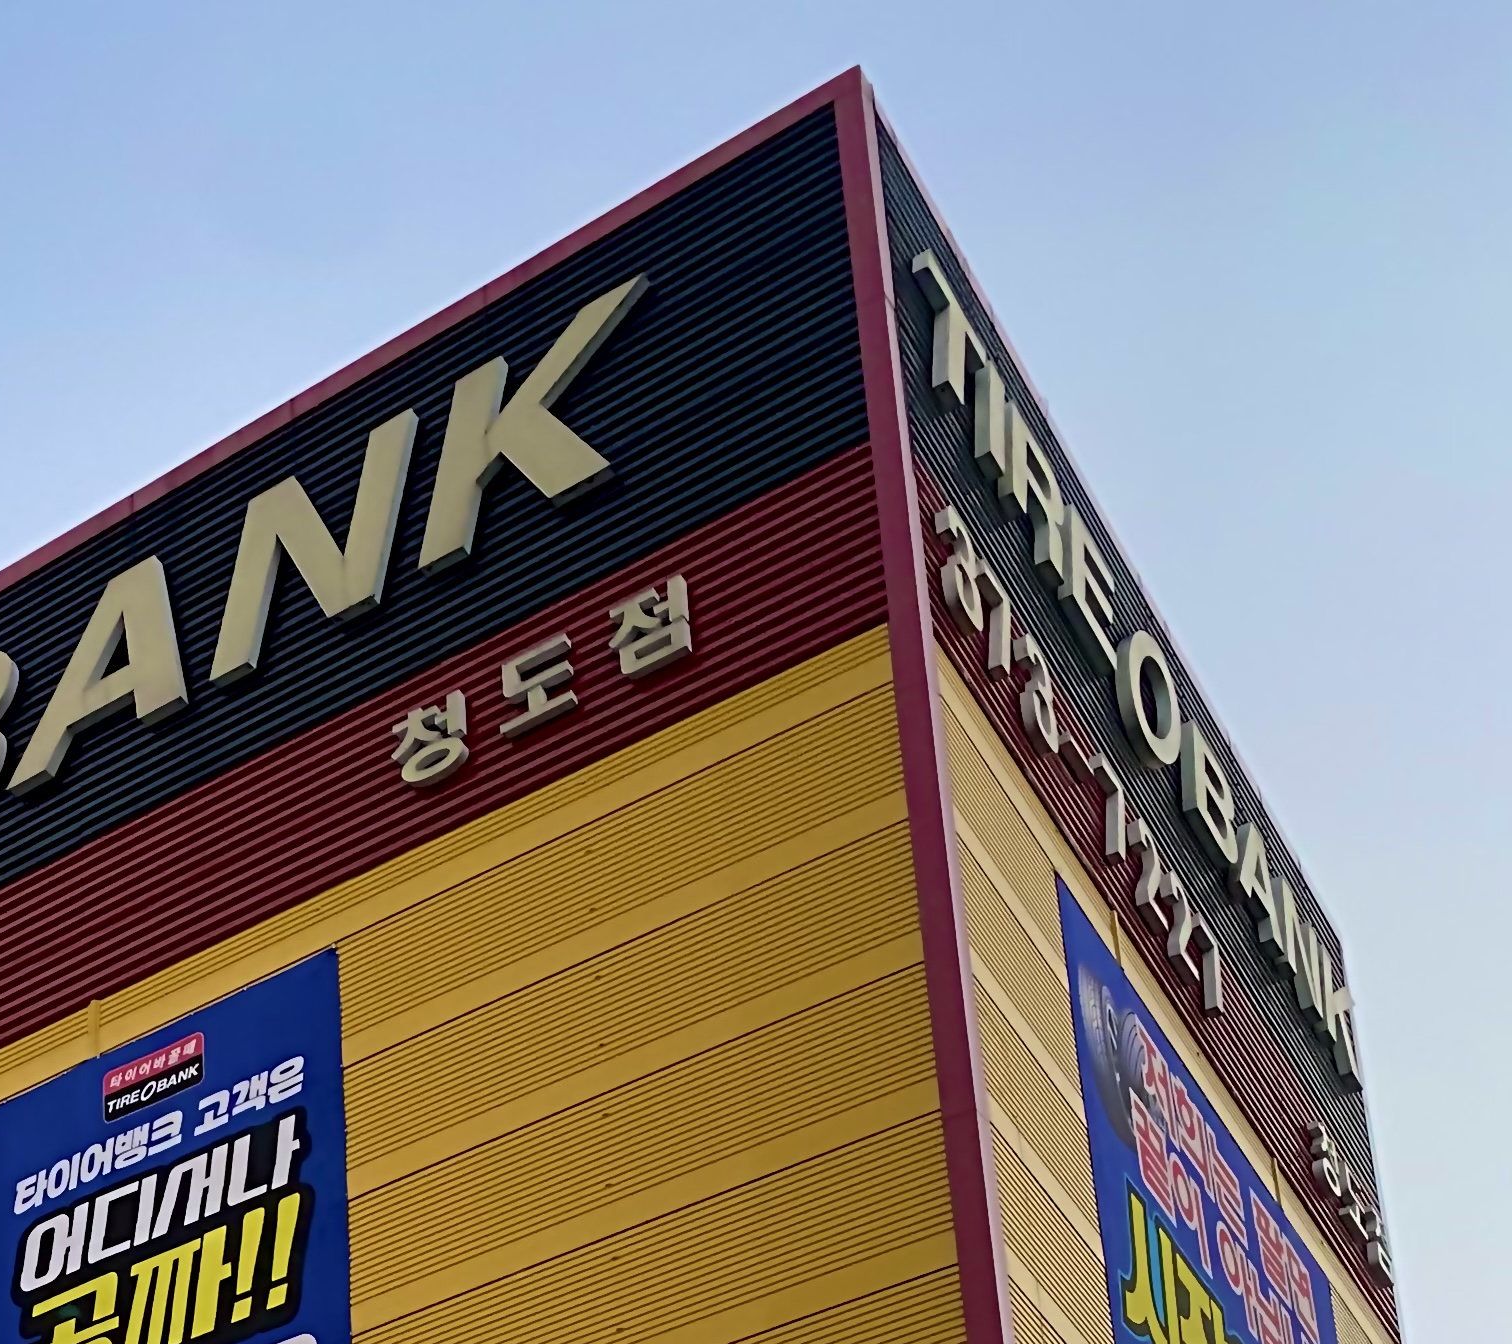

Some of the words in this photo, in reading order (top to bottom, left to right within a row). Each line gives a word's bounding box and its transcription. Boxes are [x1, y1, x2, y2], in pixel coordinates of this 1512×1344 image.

[391, 573, 693, 788] 청도점
[934, 504, 1225, 1018] 373-7227
[13, 1110, 183, 1215] 타이어뱅크
[194, 1055, 304, 1137] 고객은
[1130, 1096, 1212, 1279] 끝이
[1134, 1013, 1248, 1250] 저희는
